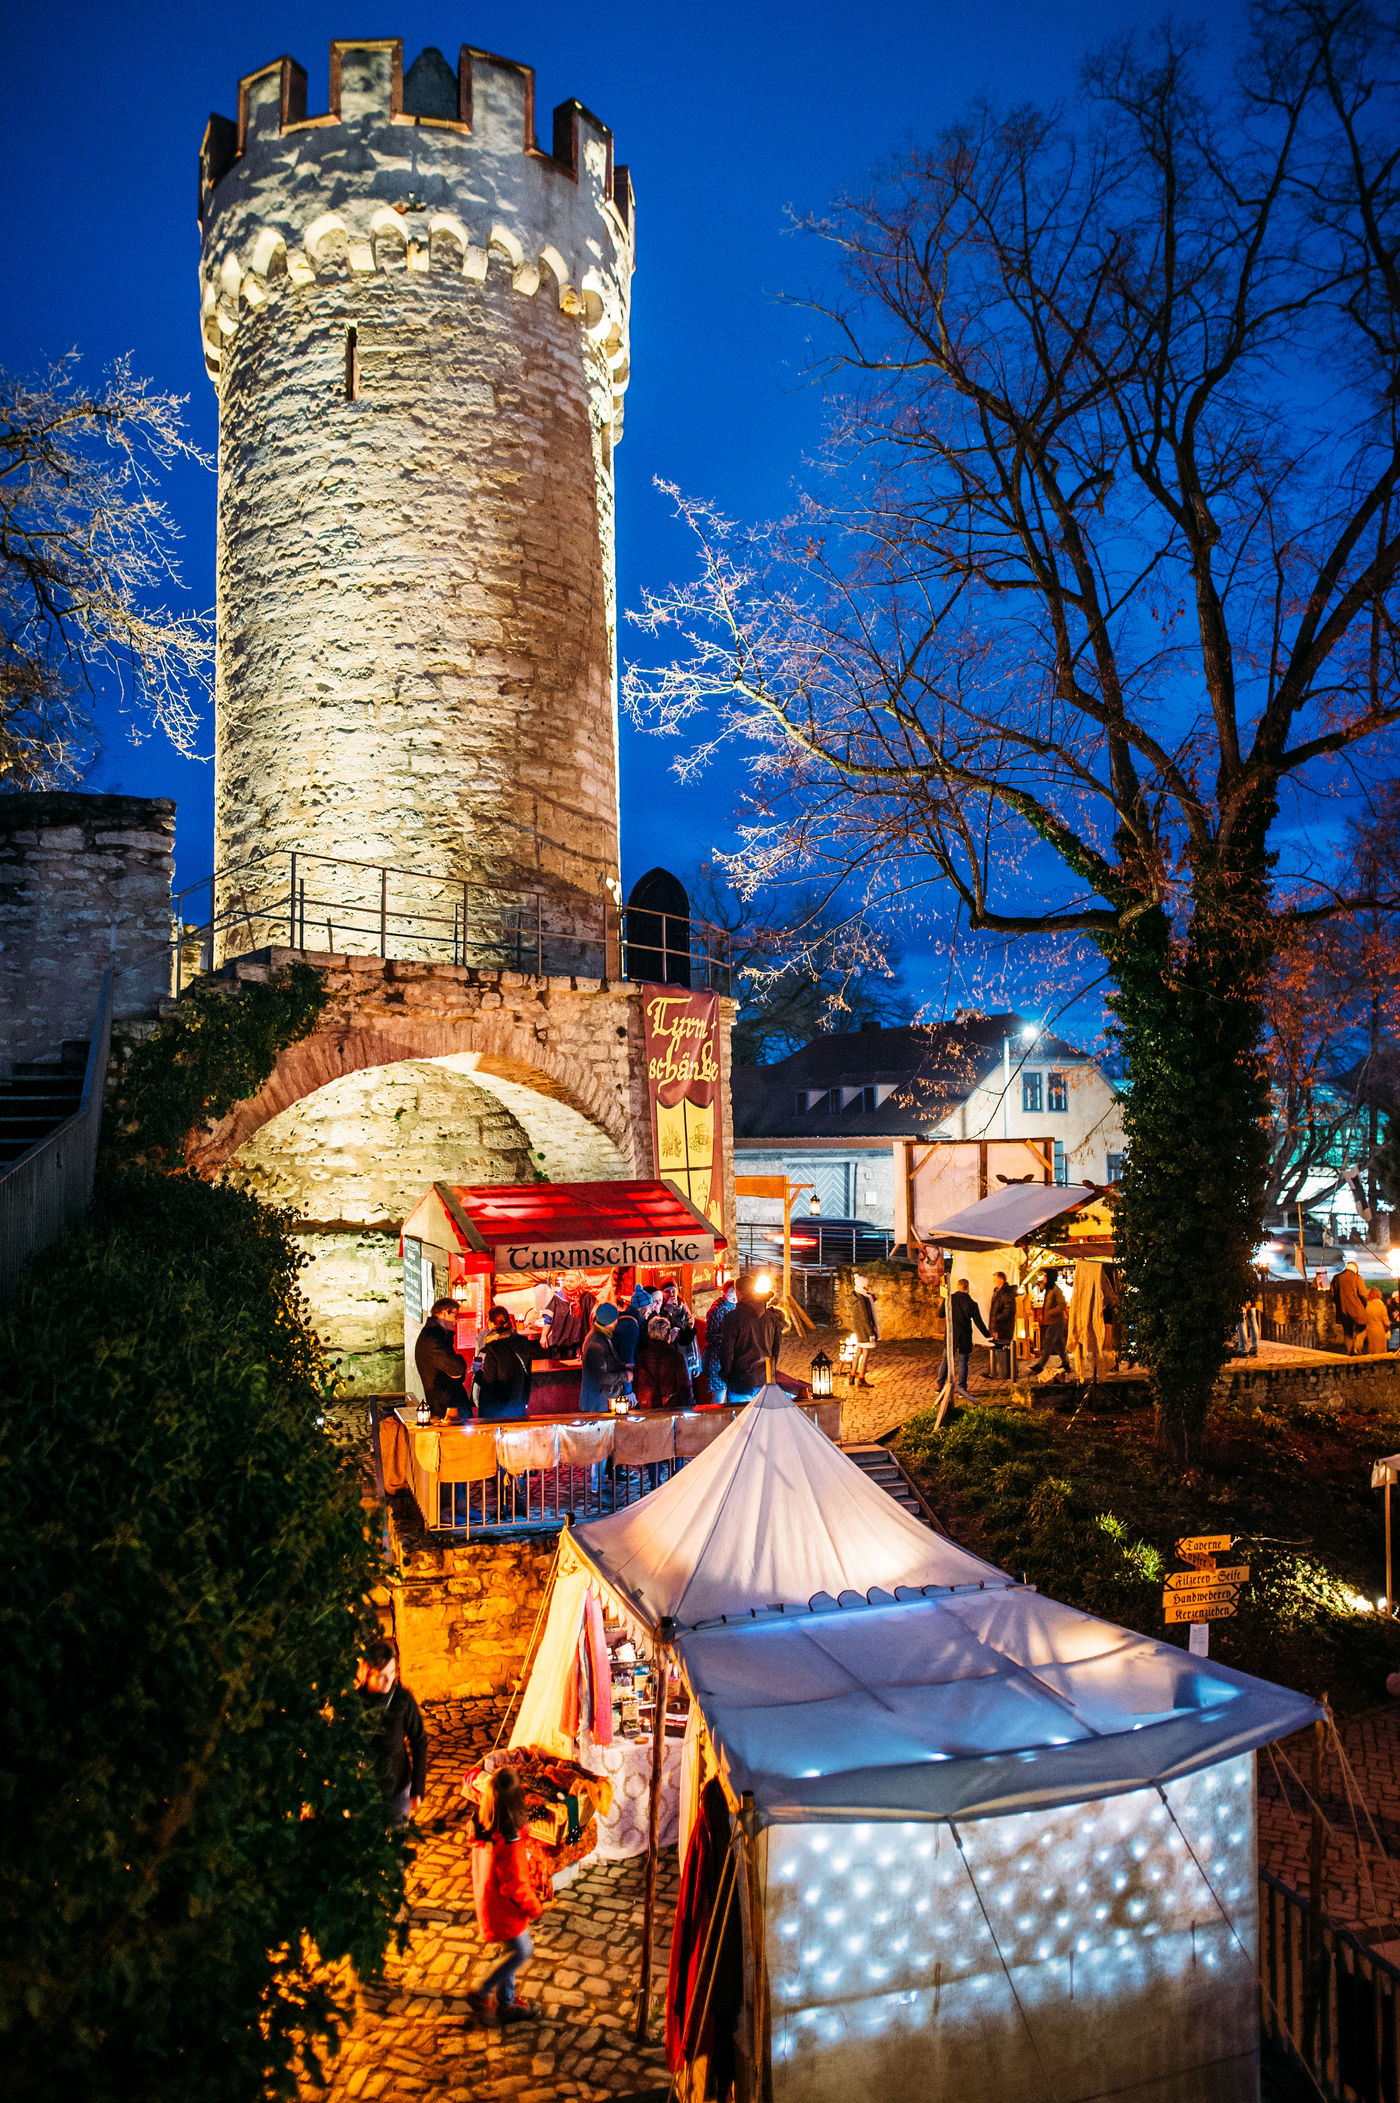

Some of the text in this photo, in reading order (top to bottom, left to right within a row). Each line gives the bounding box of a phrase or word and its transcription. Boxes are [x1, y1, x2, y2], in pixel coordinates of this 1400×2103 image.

[648, 1036, 718, 1094] schänke
[507, 1239, 700, 1271] Turmschänke
[1186, 1540, 1221, 1551] Taverne
[1173, 1590, 1231, 1605] Handweberey
[1175, 1606, 1230, 1620] Kerzenziehen
